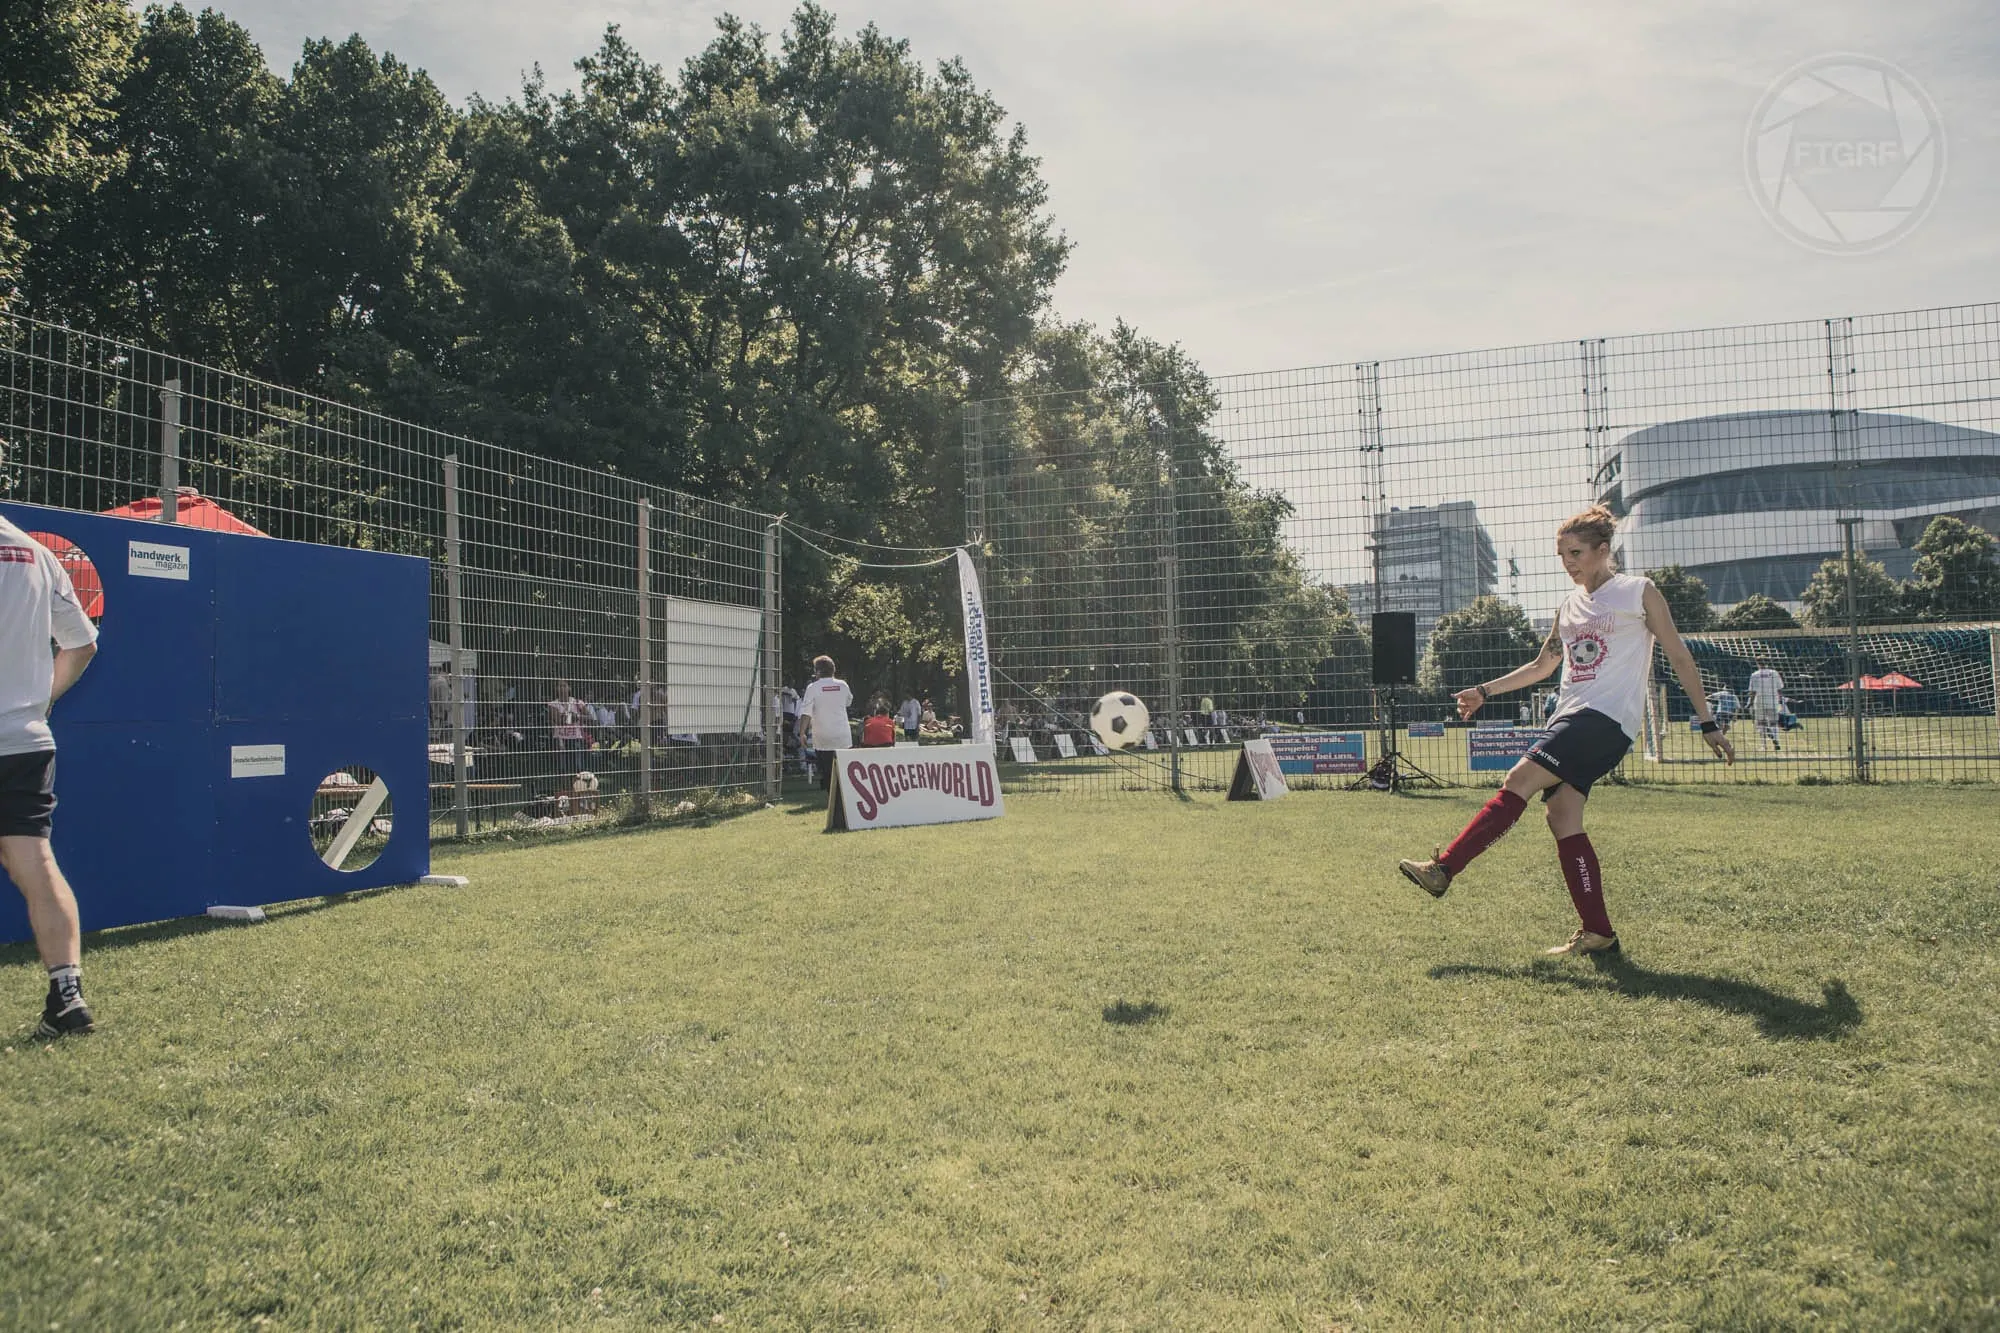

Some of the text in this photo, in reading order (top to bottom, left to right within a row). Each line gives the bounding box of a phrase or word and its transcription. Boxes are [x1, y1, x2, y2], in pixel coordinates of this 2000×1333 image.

[130, 548, 182, 563] handwerk
[155, 560, 189, 571] magazin
[1536, 750, 1561, 767] PATRICK
[847, 760, 995, 821] SOCCERWORLD
[1578, 863, 1593, 894] PATRICK
